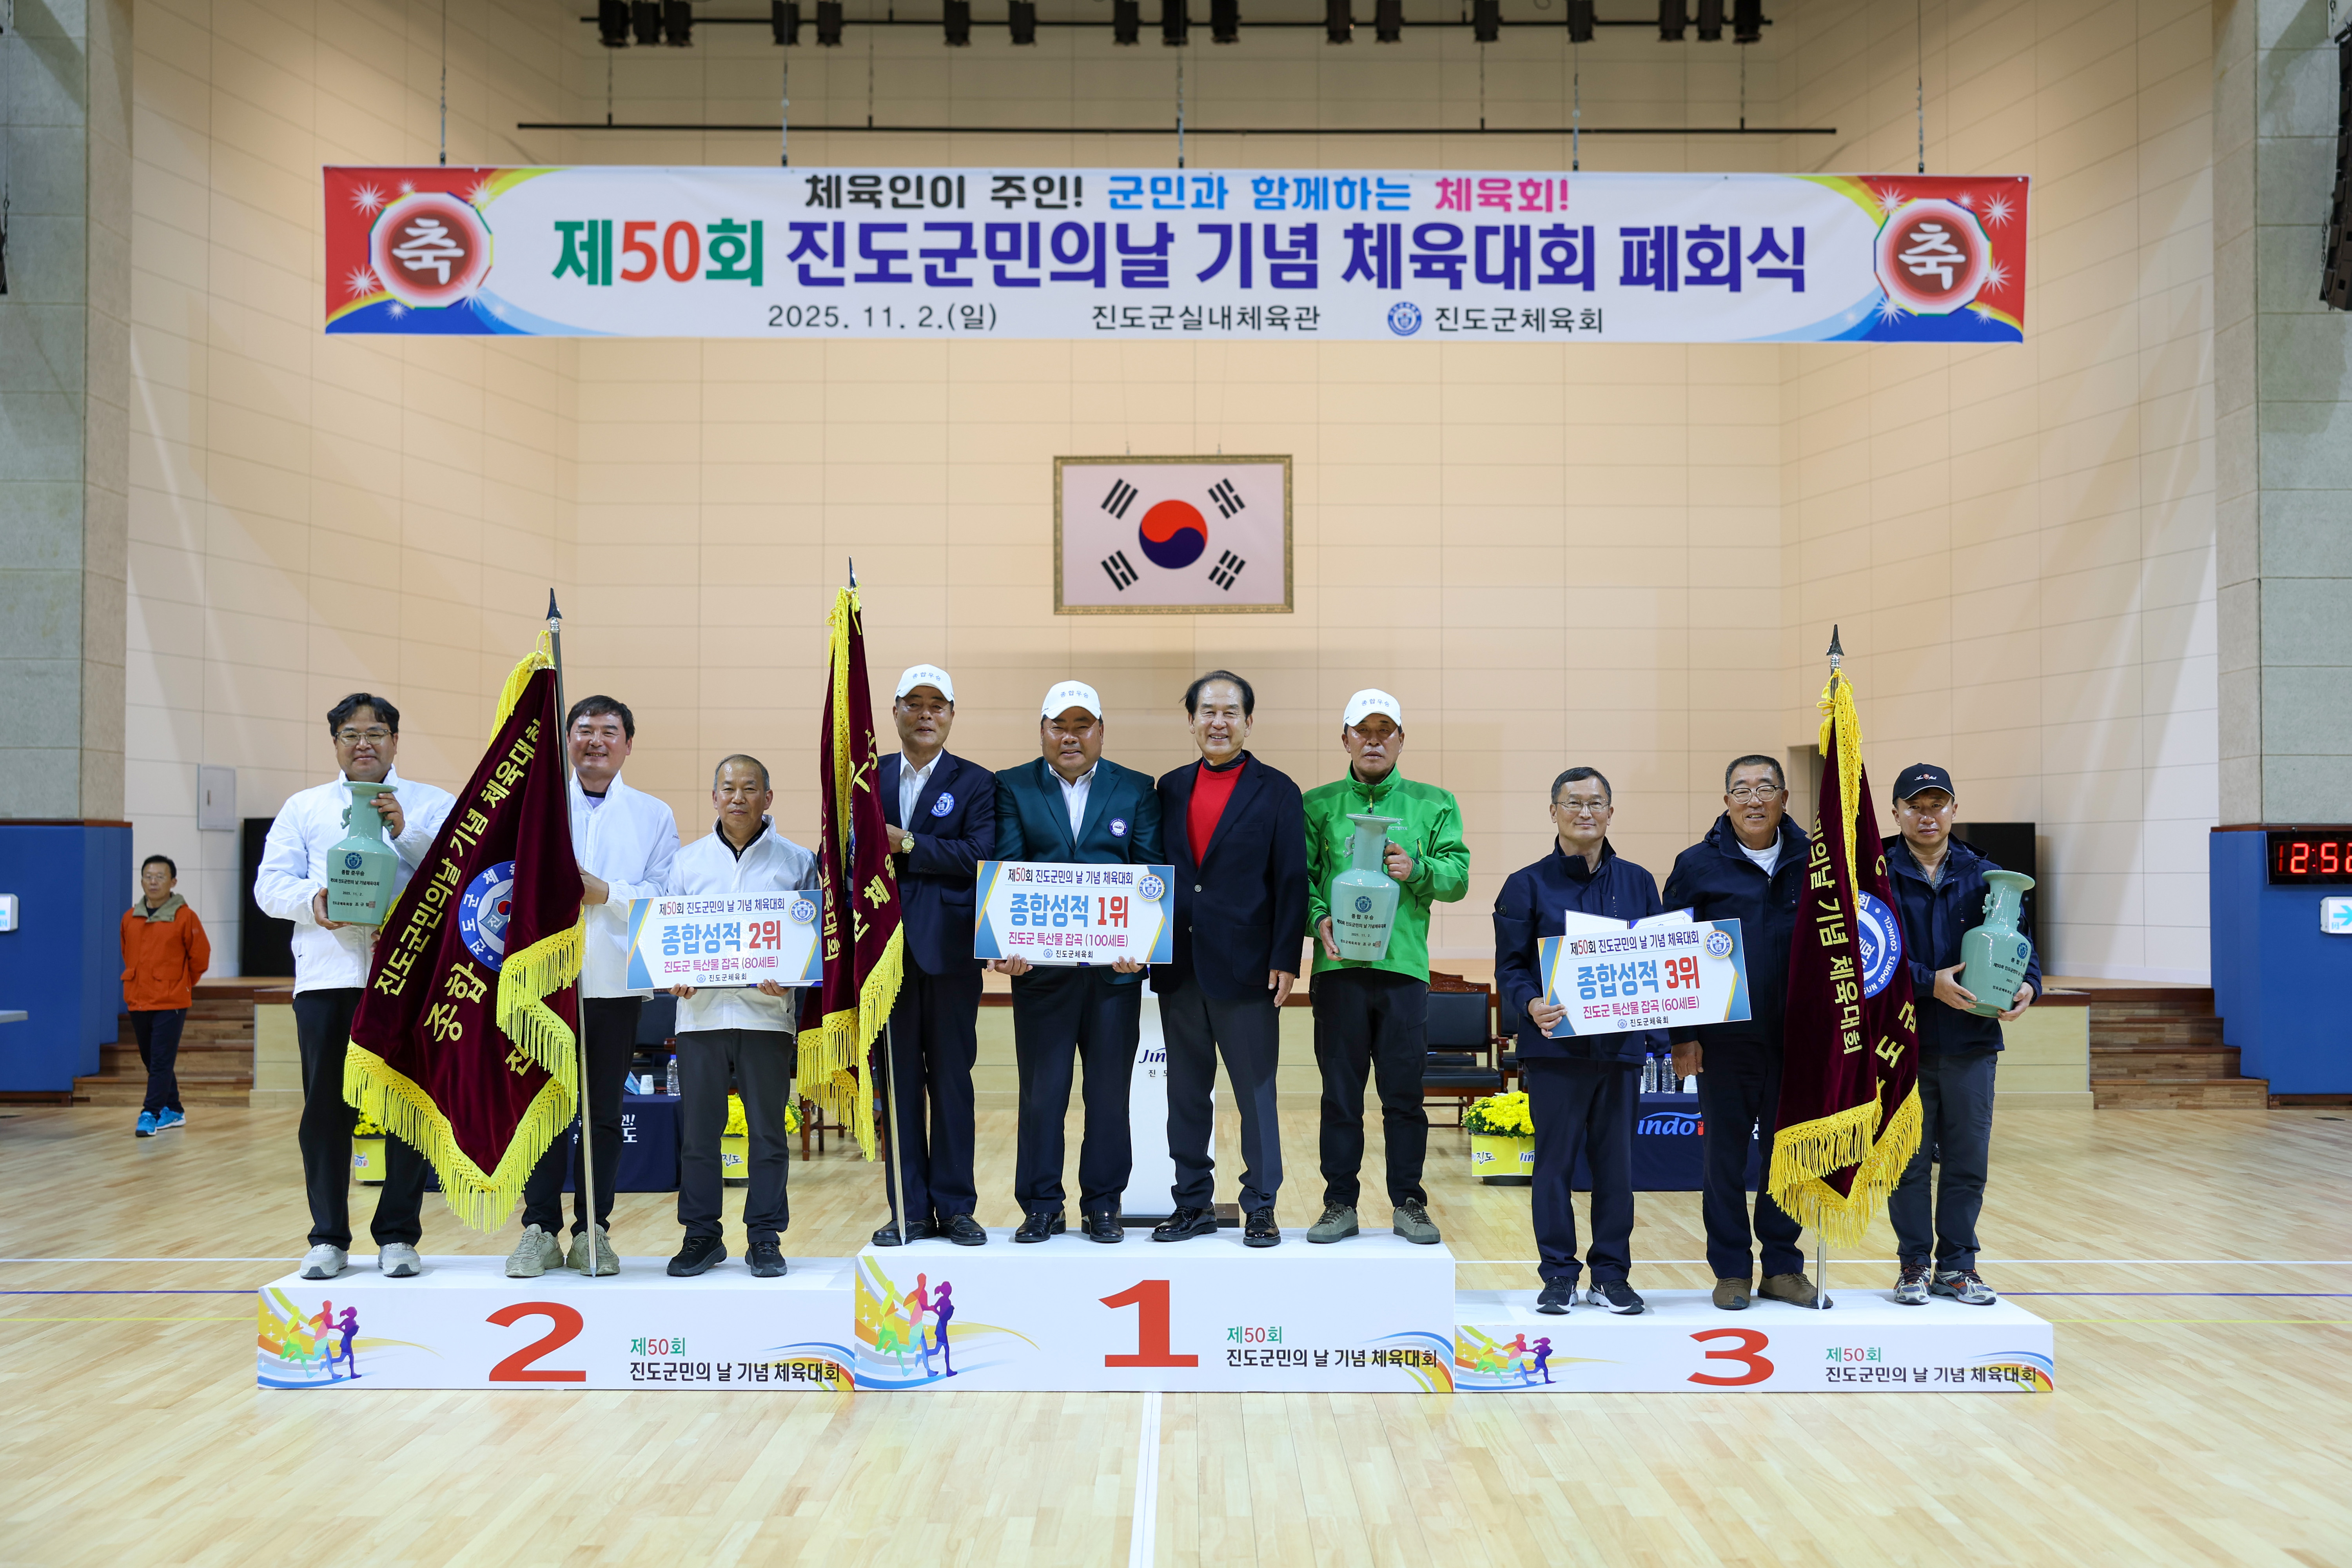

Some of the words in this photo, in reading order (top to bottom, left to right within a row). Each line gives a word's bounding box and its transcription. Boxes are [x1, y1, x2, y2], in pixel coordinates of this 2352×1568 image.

[805, 175, 965, 208] 체육인이
[991, 176, 1083, 209] 주인!
[1108, 176, 1229, 210] 군민과
[1252, 176, 1410, 211] 함께하는
[1435, 177, 1568, 212] 체육회!
[392, 218, 465, 285] 축
[552, 218, 764, 286] 제50회
[787, 221, 1174, 289] 진도군민의날
[1196, 223, 1318, 289] 기념
[1341, 222, 1595, 291] 체육대회
[1620, 224, 1805, 292] 폐회식
[1898, 222, 1966, 290] 축
[769, 305, 849, 328] 2025.
[864, 305, 905, 328] 11.
[918, 303, 997, 331] 2.(일)
[1093, 305, 1320, 331] 진도군실내체육관
[1435, 307, 1602, 334] 진도군체육회
[1061, 690, 1089, 699] 종합우승
[1361, 699, 1390, 707] 종합우승
[1008, 867, 1033, 882] 제50회
[1036, 869, 1073, 884] 진도군민의
[1076, 871, 1083, 884] 날
[1086, 871, 1100, 884] 기념
[1103, 871, 1133, 885] 체육대회
[374, 858, 462, 996] 진도군민의날
[450, 808, 489, 857] 기념
[659, 901, 684, 915] 제50회
[687, 900, 724, 914] 진도군민의
[727, 900, 735, 913] 날
[737, 899, 752, 911] 기념
[755, 898, 784, 911] 체육대회
[1010, 893, 1089, 927] 종합성적
[1098, 896, 1128, 927] 1위
[1817, 898, 1849, 946] 기념
[1884, 916, 1897, 951] COUNCIL
[662, 922, 740, 956] 종합성적
[749, 920, 781, 950] 2위
[1009, 932, 1034, 945] 진도군
[1037, 933, 1063, 946] 특산물
[1065, 933, 1082, 946] 잡곡
[1085, 934, 1128, 947] (100세트)
[1570, 939, 1596, 955] 제50회
[1599, 937, 1637, 953] 진도군민의
[1640, 936, 1648, 949] 날
[1650, 933, 1665, 948] 기념
[1668, 930, 1699, 946] 체육대회
[664, 960, 690, 973] 진도군
[693, 959, 720, 971] 특산물
[722, 958, 739, 970] 잡곡
[742, 956, 778, 969] (80세트)
[1056, 950, 1093, 958] 진도군체육회
[709, 973, 747, 982] 진도군체육회
[1577, 960, 1659, 1000] 종합성적
[1665, 956, 1700, 989] 3위
[1878, 956, 1895, 984] SPORTS
[423, 962, 487, 1042] 종합
[1583, 1004, 1610, 1019] 진도군
[1612, 1002, 1639, 1016] 특산물
[1641, 1000, 1659, 1013] 잡곡
[1661, 996, 1700, 1012] (60세트)
[1830, 956, 1862, 1054] 체육대회
[1630, 1016, 1668, 1027] 진도군체육회
[722, 1154, 743, 1166] 진도
[1477, 1152, 1495, 1164] 진도
[1098, 1280, 1199, 1367] 1
[1227, 1326, 1282, 1344] 제50회
[485, 1301, 586, 1382] 2
[630, 1337, 686, 1357] 제50회
[1227, 1349, 1307, 1367] 진도군민의
[1314, 1349, 1329, 1367] 날
[1334, 1349, 1366, 1367] 기념
[1372, 1349, 1437, 1368] 체육대회
[1686, 1328, 1774, 1386] 3
[1826, 1347, 1881, 1363] 제50회
[630, 1362, 710, 1382] 진도군민의
[717, 1362, 732, 1382] 날
[737, 1362, 768, 1382] 기념
[774, 1362, 840, 1383] 체육대회
[1826, 1367, 1906, 1383] 진도군민의
[1913, 1367, 1928, 1383] 날
[1934, 1367, 1965, 1383] 기념
[1971, 1367, 2036, 1383] 체육대회
